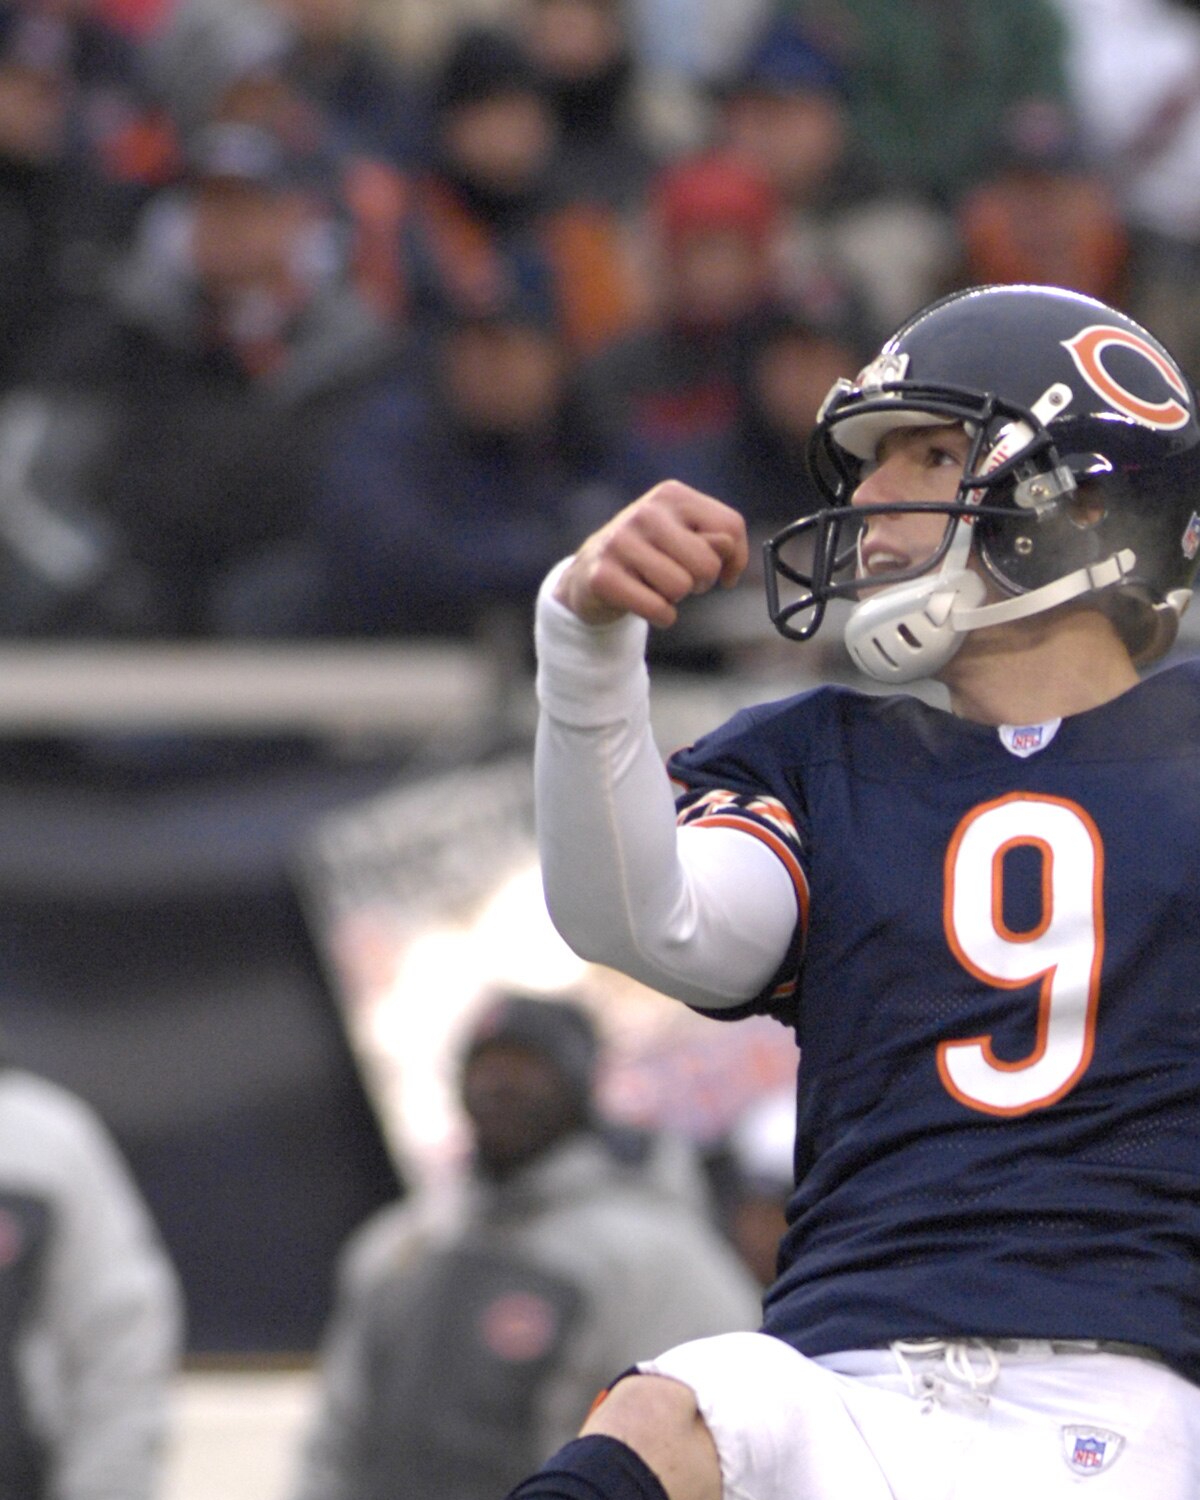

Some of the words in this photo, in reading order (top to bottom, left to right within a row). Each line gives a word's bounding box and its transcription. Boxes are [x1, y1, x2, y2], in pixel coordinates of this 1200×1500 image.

[1012, 733, 1041, 750] NFL
[936, 790, 1104, 1117] 9
[1073, 1449, 1102, 1467] NFL
